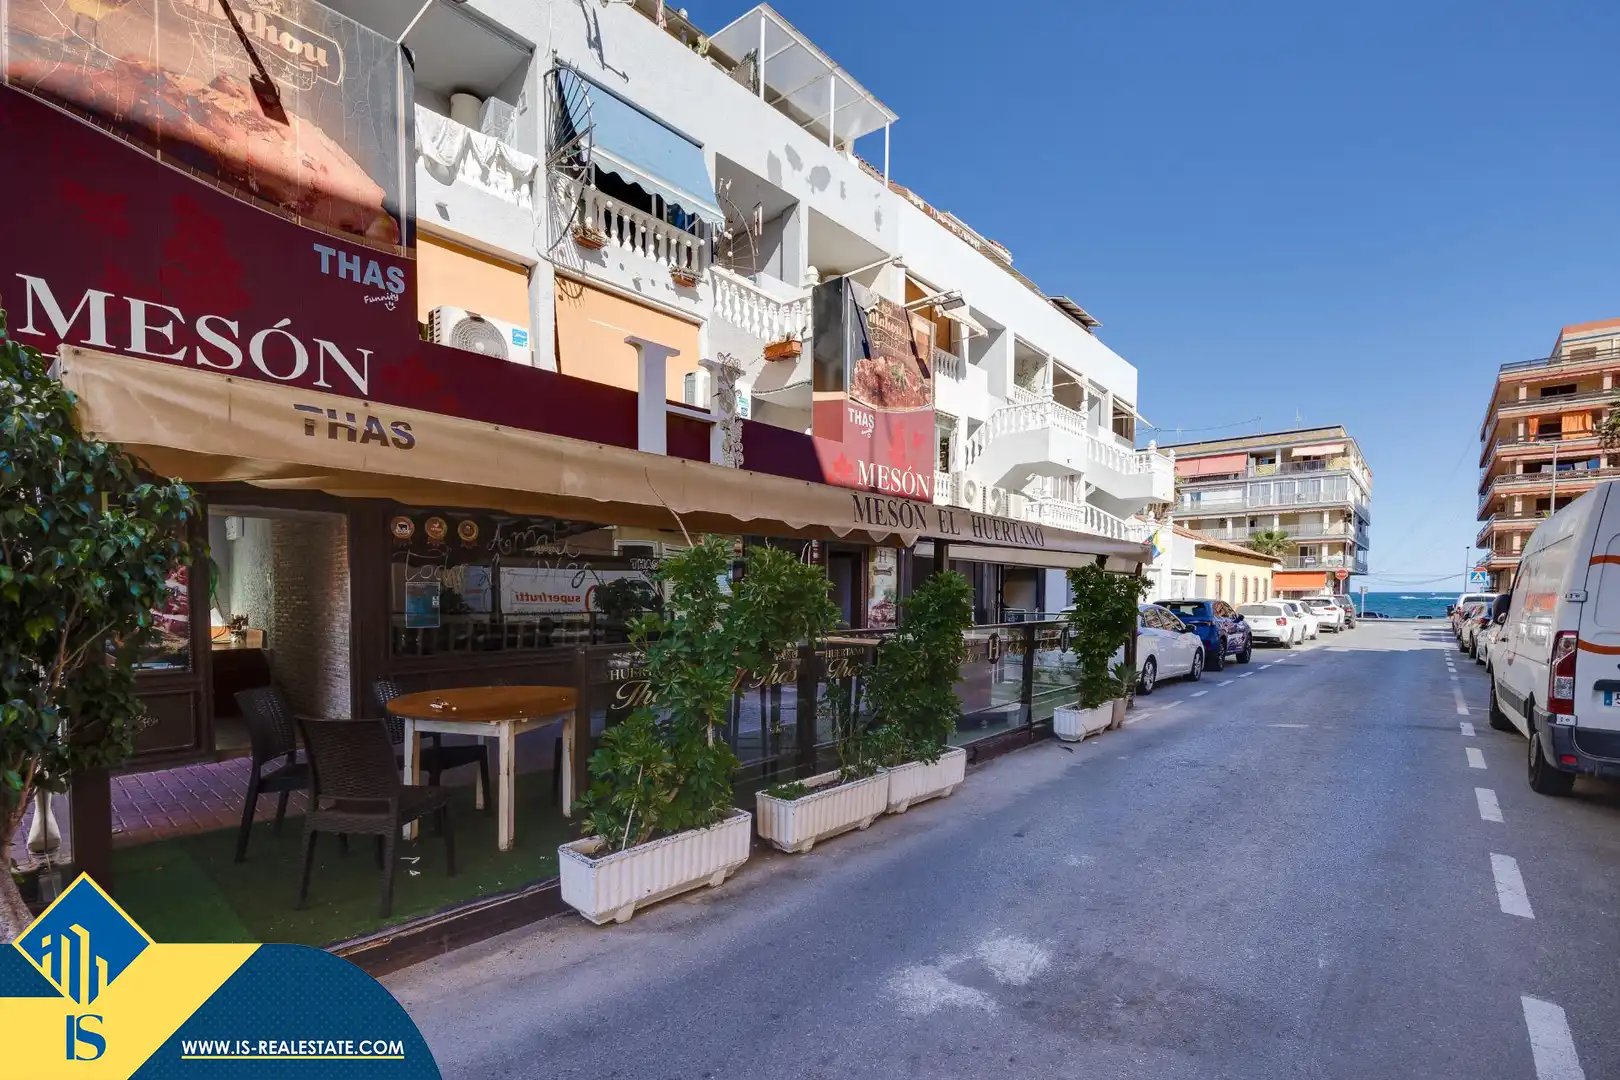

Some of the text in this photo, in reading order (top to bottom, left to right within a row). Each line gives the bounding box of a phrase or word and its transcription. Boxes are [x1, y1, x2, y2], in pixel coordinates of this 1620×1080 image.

[313, 242, 406, 294] THAS
[15, 272, 374, 396] MESÓN
[293, 403, 416, 450] THAS
[847, 407, 875, 429] THAS
[857, 459, 931, 498] MESÓN
[850, 493, 1045, 547] MESÓN EL HUERTANO
